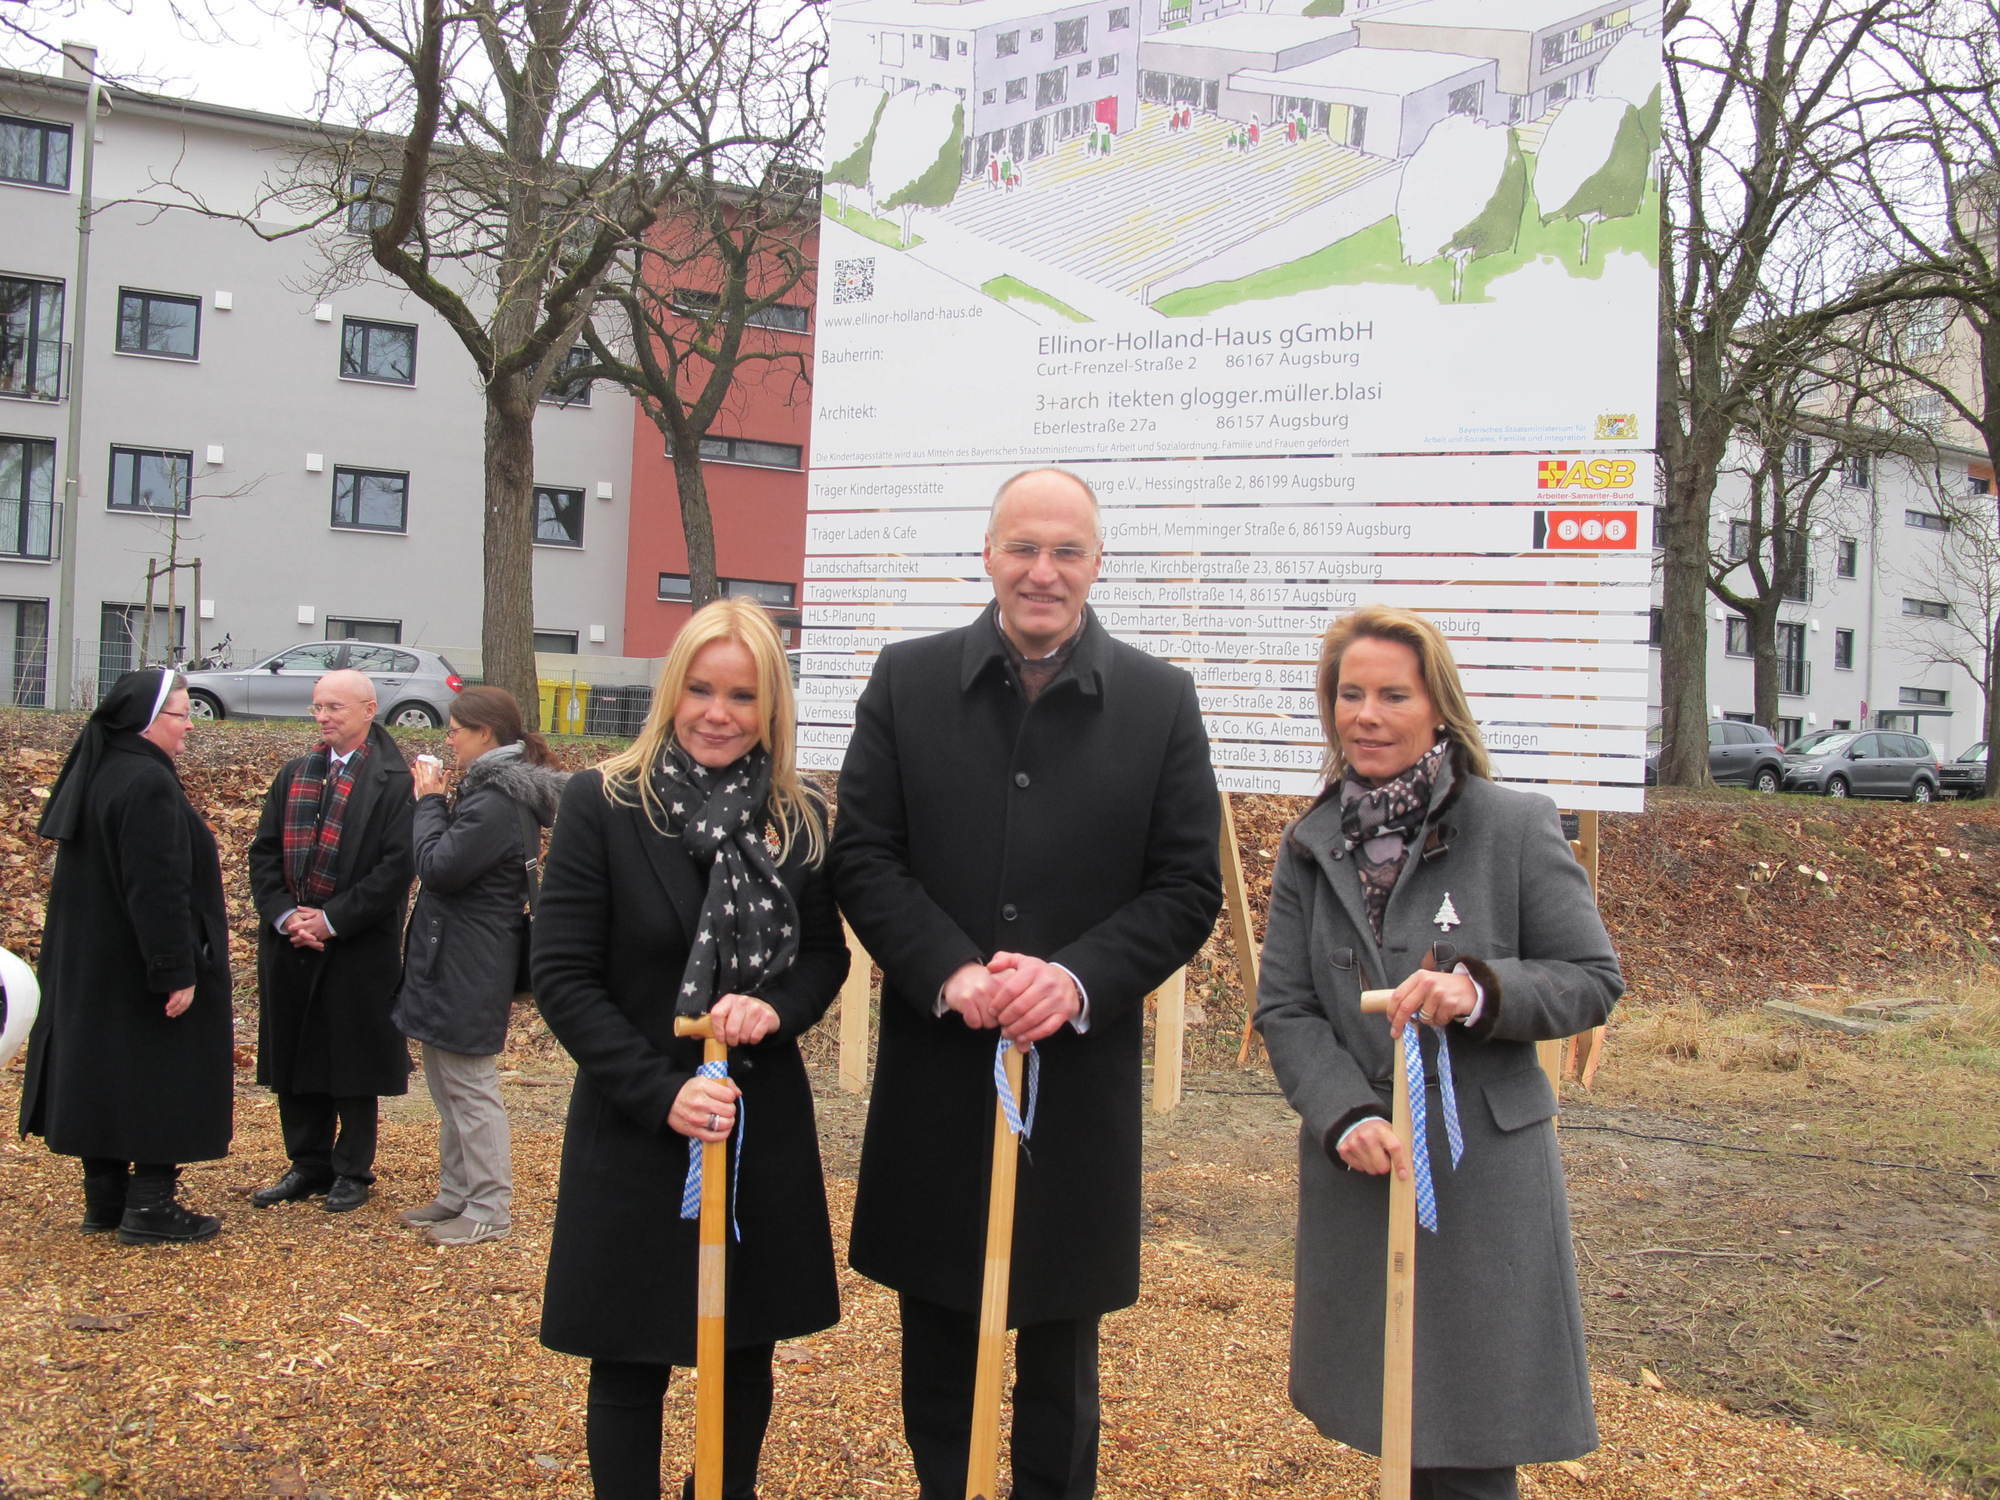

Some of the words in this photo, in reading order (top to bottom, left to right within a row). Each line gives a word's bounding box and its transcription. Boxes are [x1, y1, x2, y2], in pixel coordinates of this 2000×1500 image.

[824, 305, 983, 328] www.ellinor-holland-haus.de
[1038, 327, 1273, 356] Ellinor-Holland-Haus
[1279, 320, 1374, 349] gGmbH
[821, 348, 884, 364] Bauherrin:
[1036, 356, 1183, 377] Curt-Frenzel-Straße
[1186, 356, 1198, 371] 2
[1225, 353, 1274, 369] 86167
[1278, 350, 1360, 371] Augsburg
[1179, 381, 1383, 411] glogger.müller.blasi
[818, 404, 878, 421] Architekt:
[1033, 419, 1126, 435] Eberlestraße
[1129, 418, 1157, 433] 27a
[1215, 414, 1265, 430] 86157
[1268, 412, 1350, 431] Augsburg
[912, 450, 926, 459] aus
[927, 447, 955, 458] Mitteln
[956, 447, 970, 458] des
[971, 445, 1018, 458] Bayerischen
[1097, 442, 1108, 452] für
[1110, 441, 1136, 452] Arbeit
[1137, 441, 1154, 451] und
[1221, 438, 1254, 450] Familie
[1255, 438, 1272, 449] und
[1274, 437, 1305, 449] Frauen
[1144, 475, 1232, 493] Hessingstraße
[1234, 475, 1246, 491] 2,
[1248, 474, 1288, 489] 86199
[1291, 472, 1356, 491] Augsburg
[1557, 458, 1636, 489] ASB
[1536, 491, 1634, 500] Arbeiter-Samariter-Bund
[882, 526, 892, 540] &
[1111, 522, 1161, 539] gGmbH,
[1163, 521, 1241, 539] Memminger
[1244, 521, 1286, 537] Straße
[1288, 522, 1299, 538] 6,
[1302, 521, 1343, 537] 86159
[1346, 521, 1411, 539] Augsburg
[809, 560, 919, 576] Landschaftsarchitekt
[1102, 560, 1147, 576] Möhrle,
[1150, 559, 1250, 579] Kirchbergstraße
[1253, 561, 1272, 577] 23,
[1274, 560, 1314, 576] 86157
[1317, 560, 1383, 579] Augsburg
[808, 585, 908, 602] Tragwerksplanung
[1113, 587, 1155, 603] Reisch,
[1158, 586, 1226, 602] Pröllstraße
[1229, 588, 1247, 604] 14,
[1249, 588, 1289, 603] 86157
[1292, 588, 1357, 606] Augsburg
[808, 609, 876, 625] HLS-Planung
[1110, 611, 1180, 628] Demharter,
[1182, 613, 1335, 632] Bertha-von-Suttner-Stra
[1159, 638, 1300, 659] Dr.-Otto-Meyer-Straße
[1193, 667, 1262, 686] häfflerberg
[1265, 669, 1276, 685] 8,
[805, 682, 859, 698] Bauphysik
[1200, 694, 1273, 711] eyer-Straße
[1276, 695, 1296, 712] 28,
[804, 706, 855, 720] Vermessu
[1210, 720, 1219, 733] &
[1222, 720, 1243, 735] Co.
[1246, 721, 1267, 738] KG,
[1480, 731, 1539, 749] ertingen
[802, 751, 840, 768] SiGeKo
[1259, 748, 1270, 764] 3,
[1273, 749, 1313, 765] 86153
[1217, 773, 1281, 794] Anwalting
